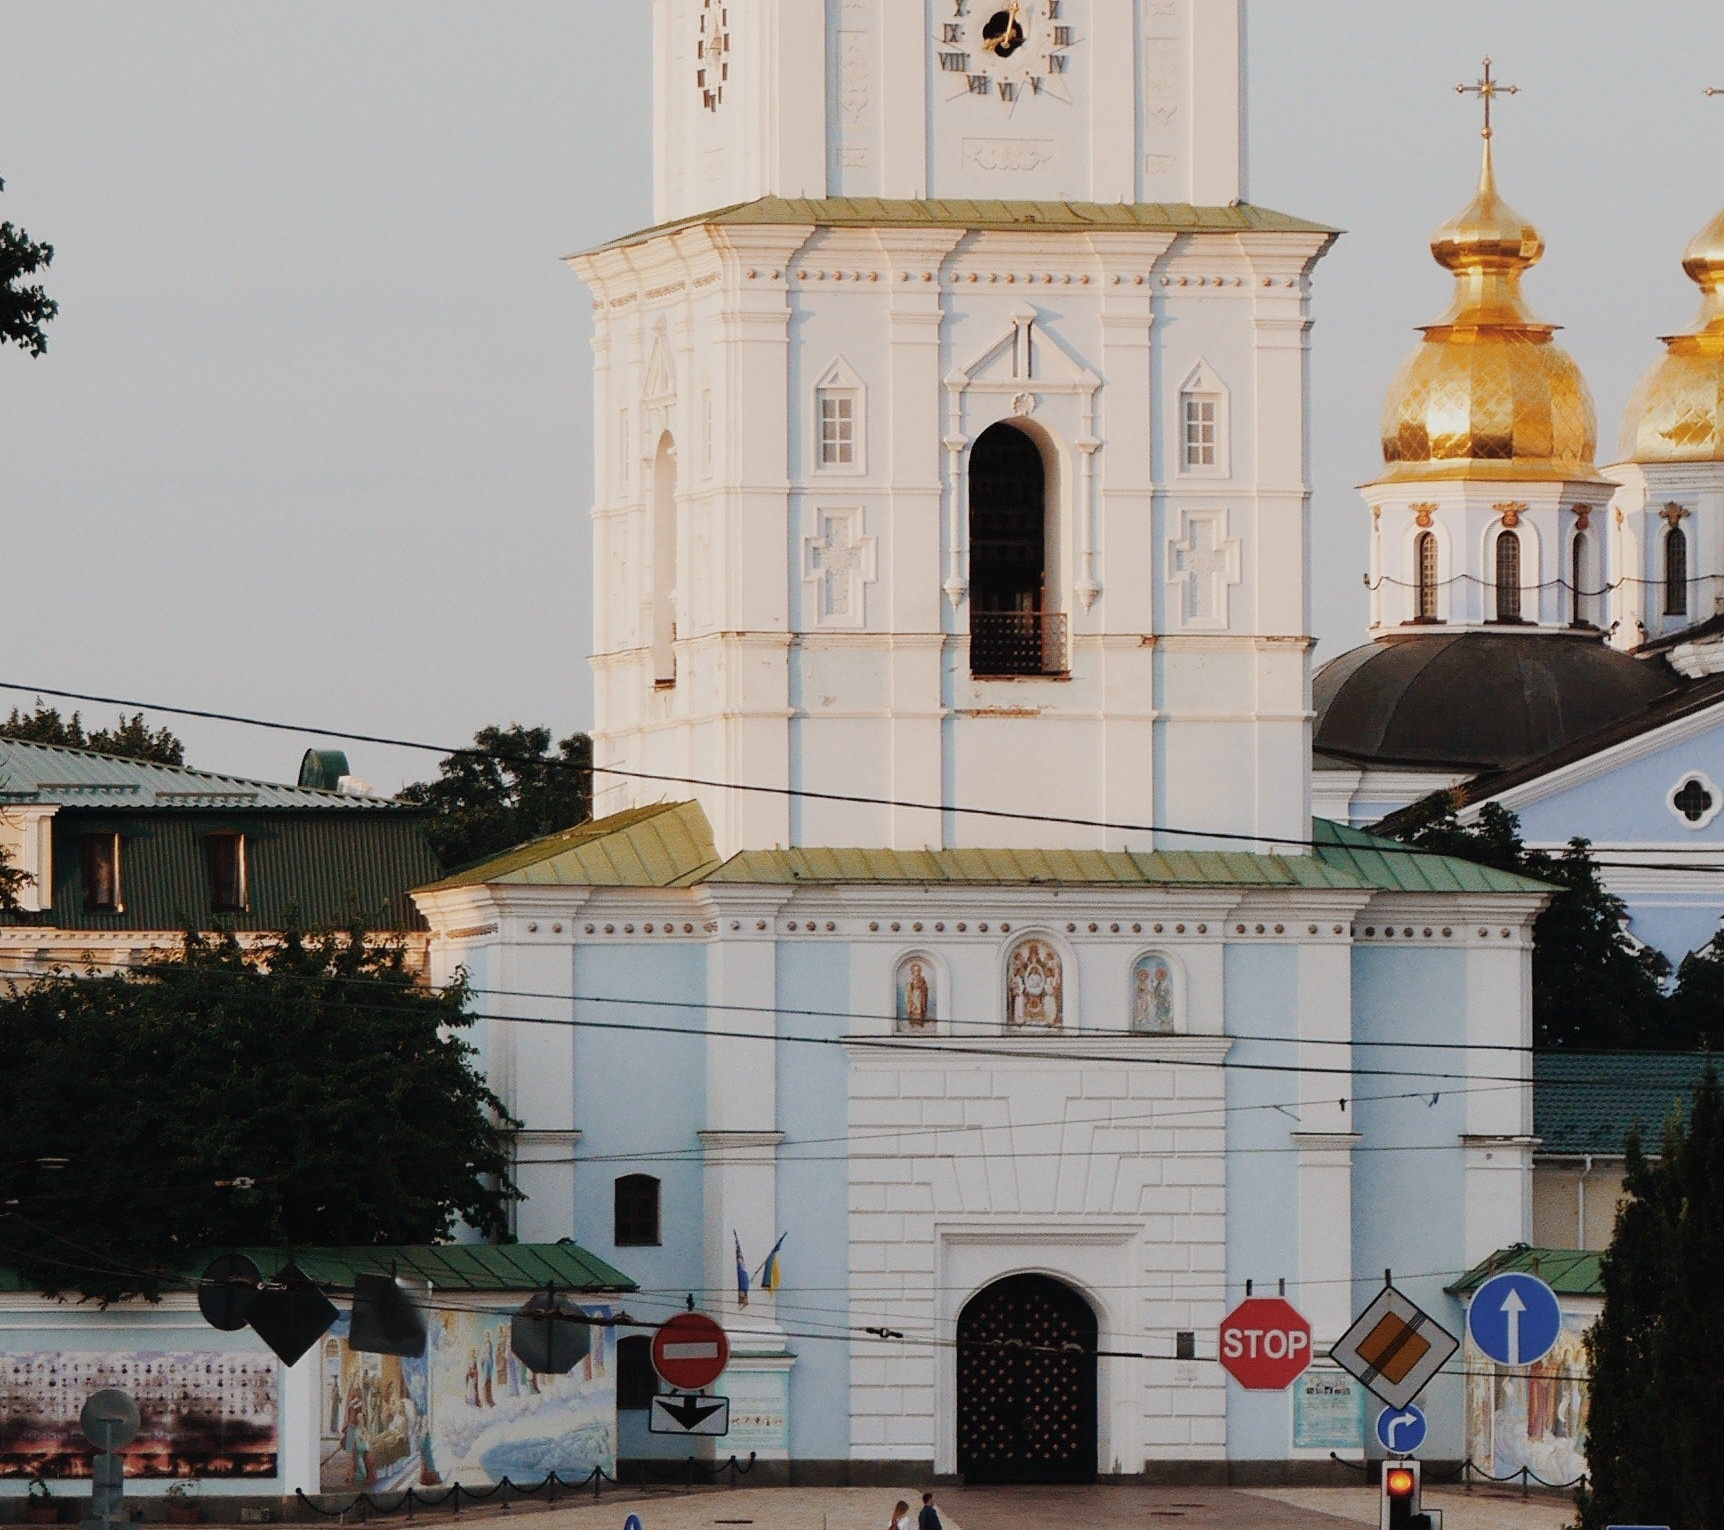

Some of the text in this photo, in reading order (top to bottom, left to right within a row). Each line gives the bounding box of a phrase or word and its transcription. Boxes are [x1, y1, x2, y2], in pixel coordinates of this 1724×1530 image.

[943, 23, 959, 43] IX
[1054, 26, 1070, 46] III
[938, 52, 966, 72] VIII
[1049, 54, 1065, 74] IV
[997, 82, 1013, 102] VI
[1029, 76, 1041, 95] V
[1224, 1328, 1308, 1359] STOP
